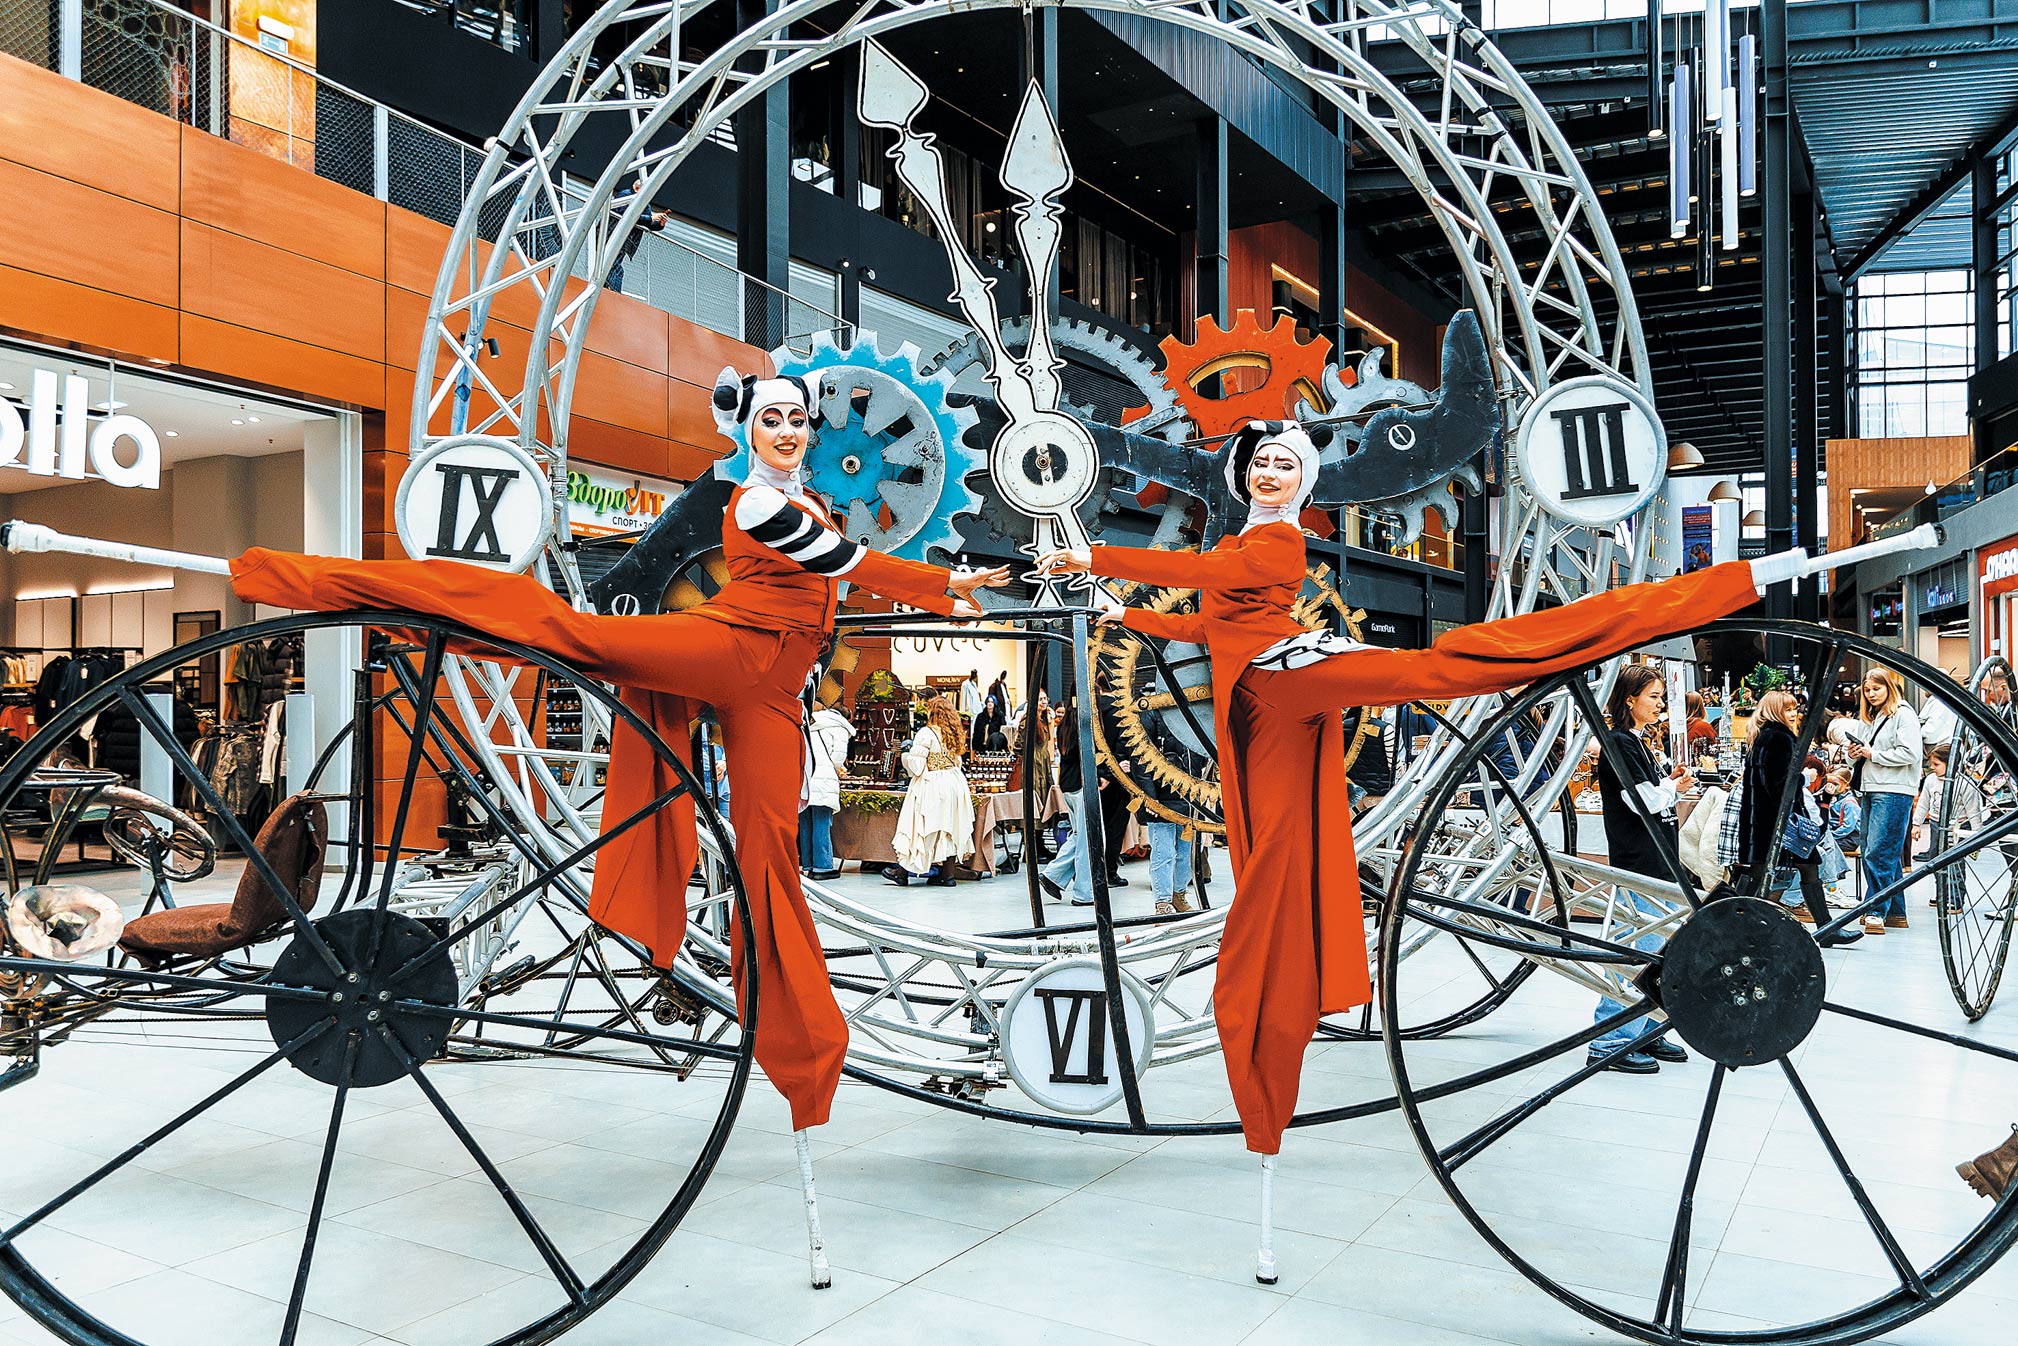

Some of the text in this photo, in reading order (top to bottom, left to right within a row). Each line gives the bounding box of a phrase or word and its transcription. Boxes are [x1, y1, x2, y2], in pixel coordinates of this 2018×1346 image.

[1550, 402, 1639, 500] III
[425, 463, 520, 563] IX
[612, 516, 638, 529] СПОРТ
[1033, 987, 1109, 1085] VI
